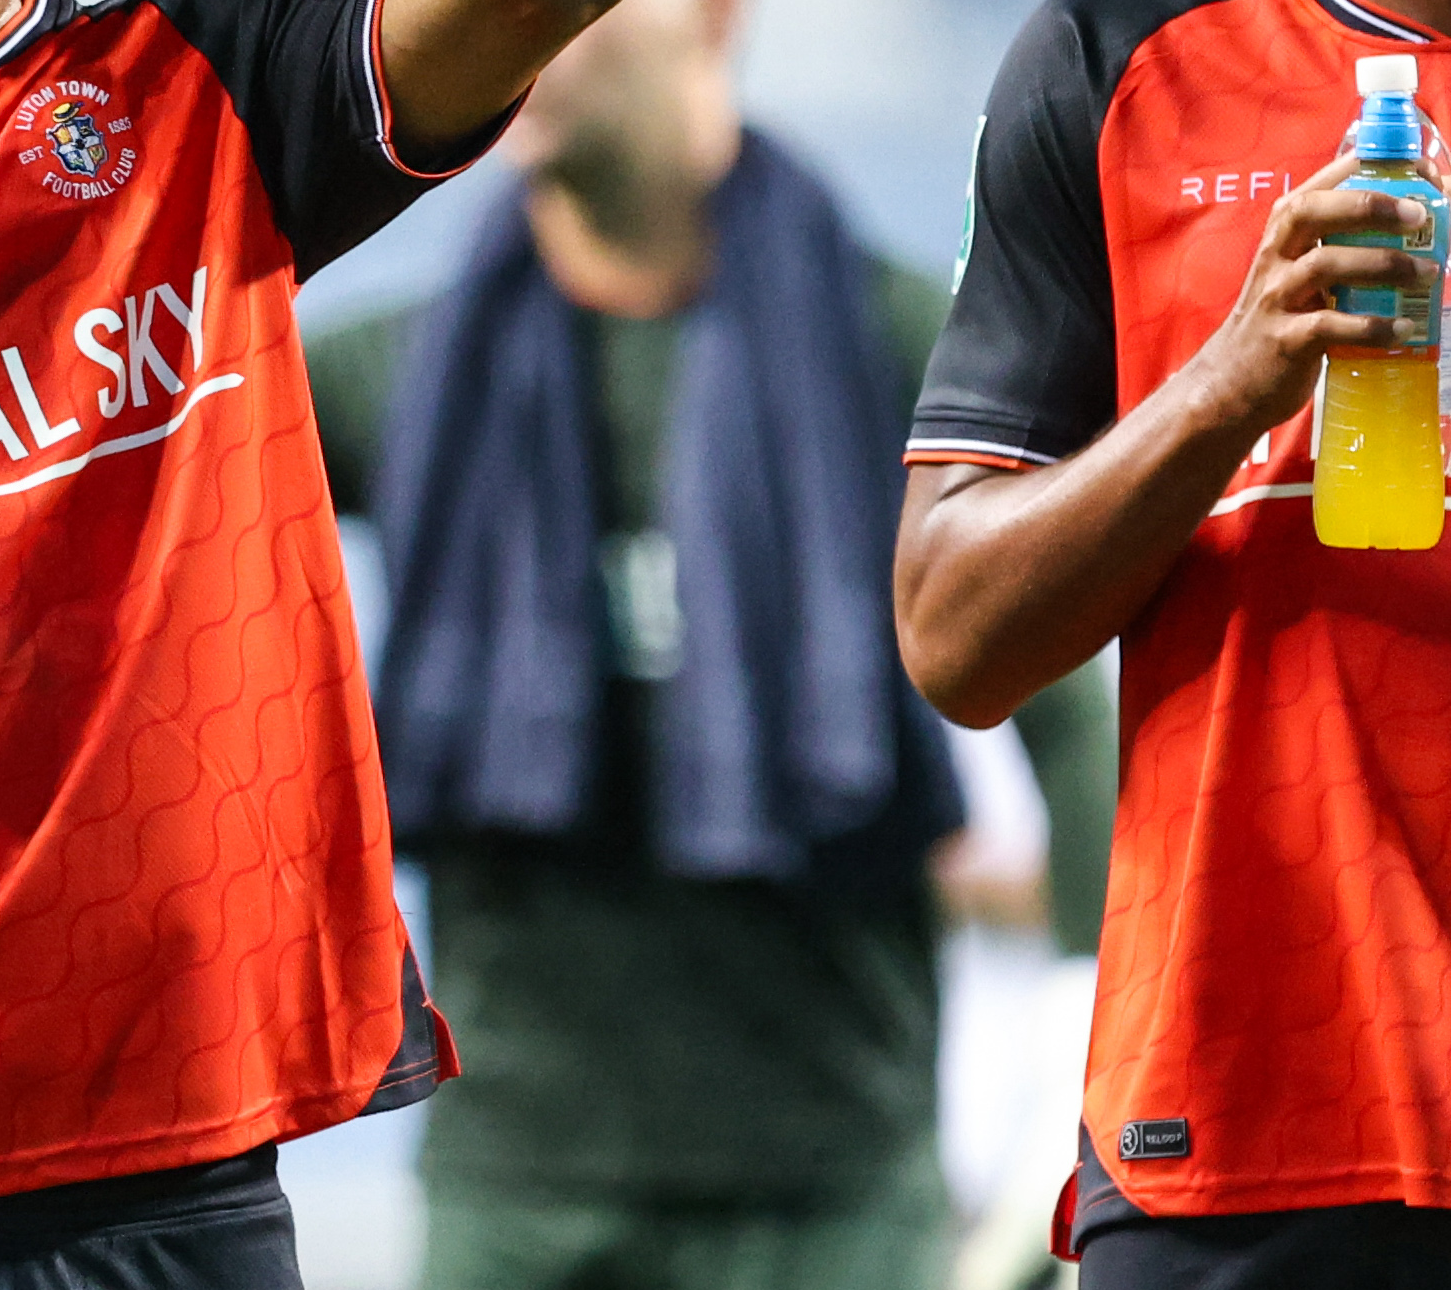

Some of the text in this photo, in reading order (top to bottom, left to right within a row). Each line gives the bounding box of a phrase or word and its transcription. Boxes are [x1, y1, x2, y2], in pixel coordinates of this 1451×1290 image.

[15, 80, 110, 130] LUTON TOWN
[18, 146, 44, 165] EST
[42, 148, 137, 200] FOOTBALL CLUB
[73, 266, 208, 419] SKY
